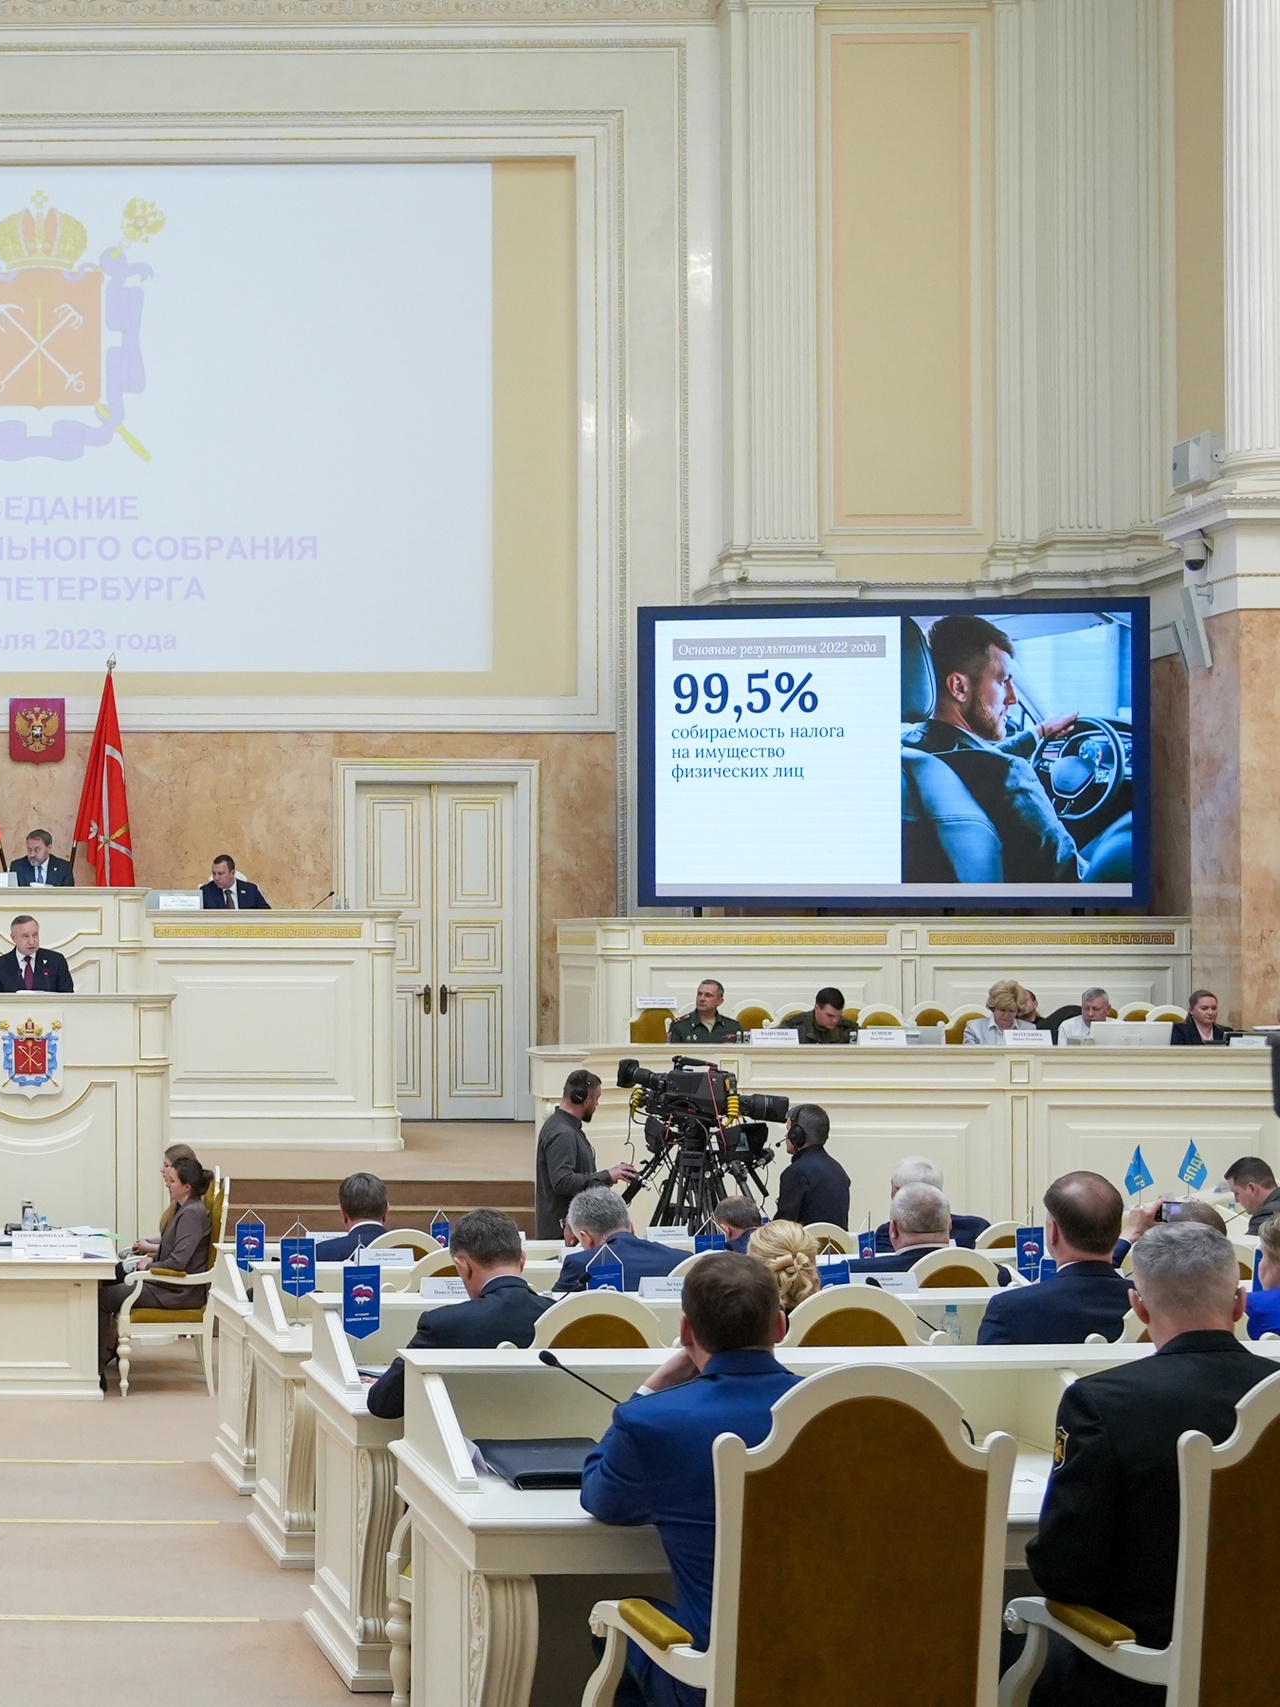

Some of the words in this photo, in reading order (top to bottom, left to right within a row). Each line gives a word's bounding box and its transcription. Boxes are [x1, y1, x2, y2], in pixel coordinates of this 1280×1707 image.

[132, 536, 318, 562] СОБРАНИЯ
[45, 629, 107, 650] 2023
[116, 633, 177, 653] года
[678, 643, 737, 655] Основные
[740, 644, 817, 658] результаты
[819, 641, 848, 654] 2022
[850, 641, 877, 653] года
[673, 669, 818, 723] 99,5%
[672, 722, 786, 743] собираемость
[790, 726, 845, 739] налога
[672, 748, 690, 759] на
[695, 746, 786, 763] имущество
[672, 764, 769, 783] физических
[772, 767, 805, 780] лиц
